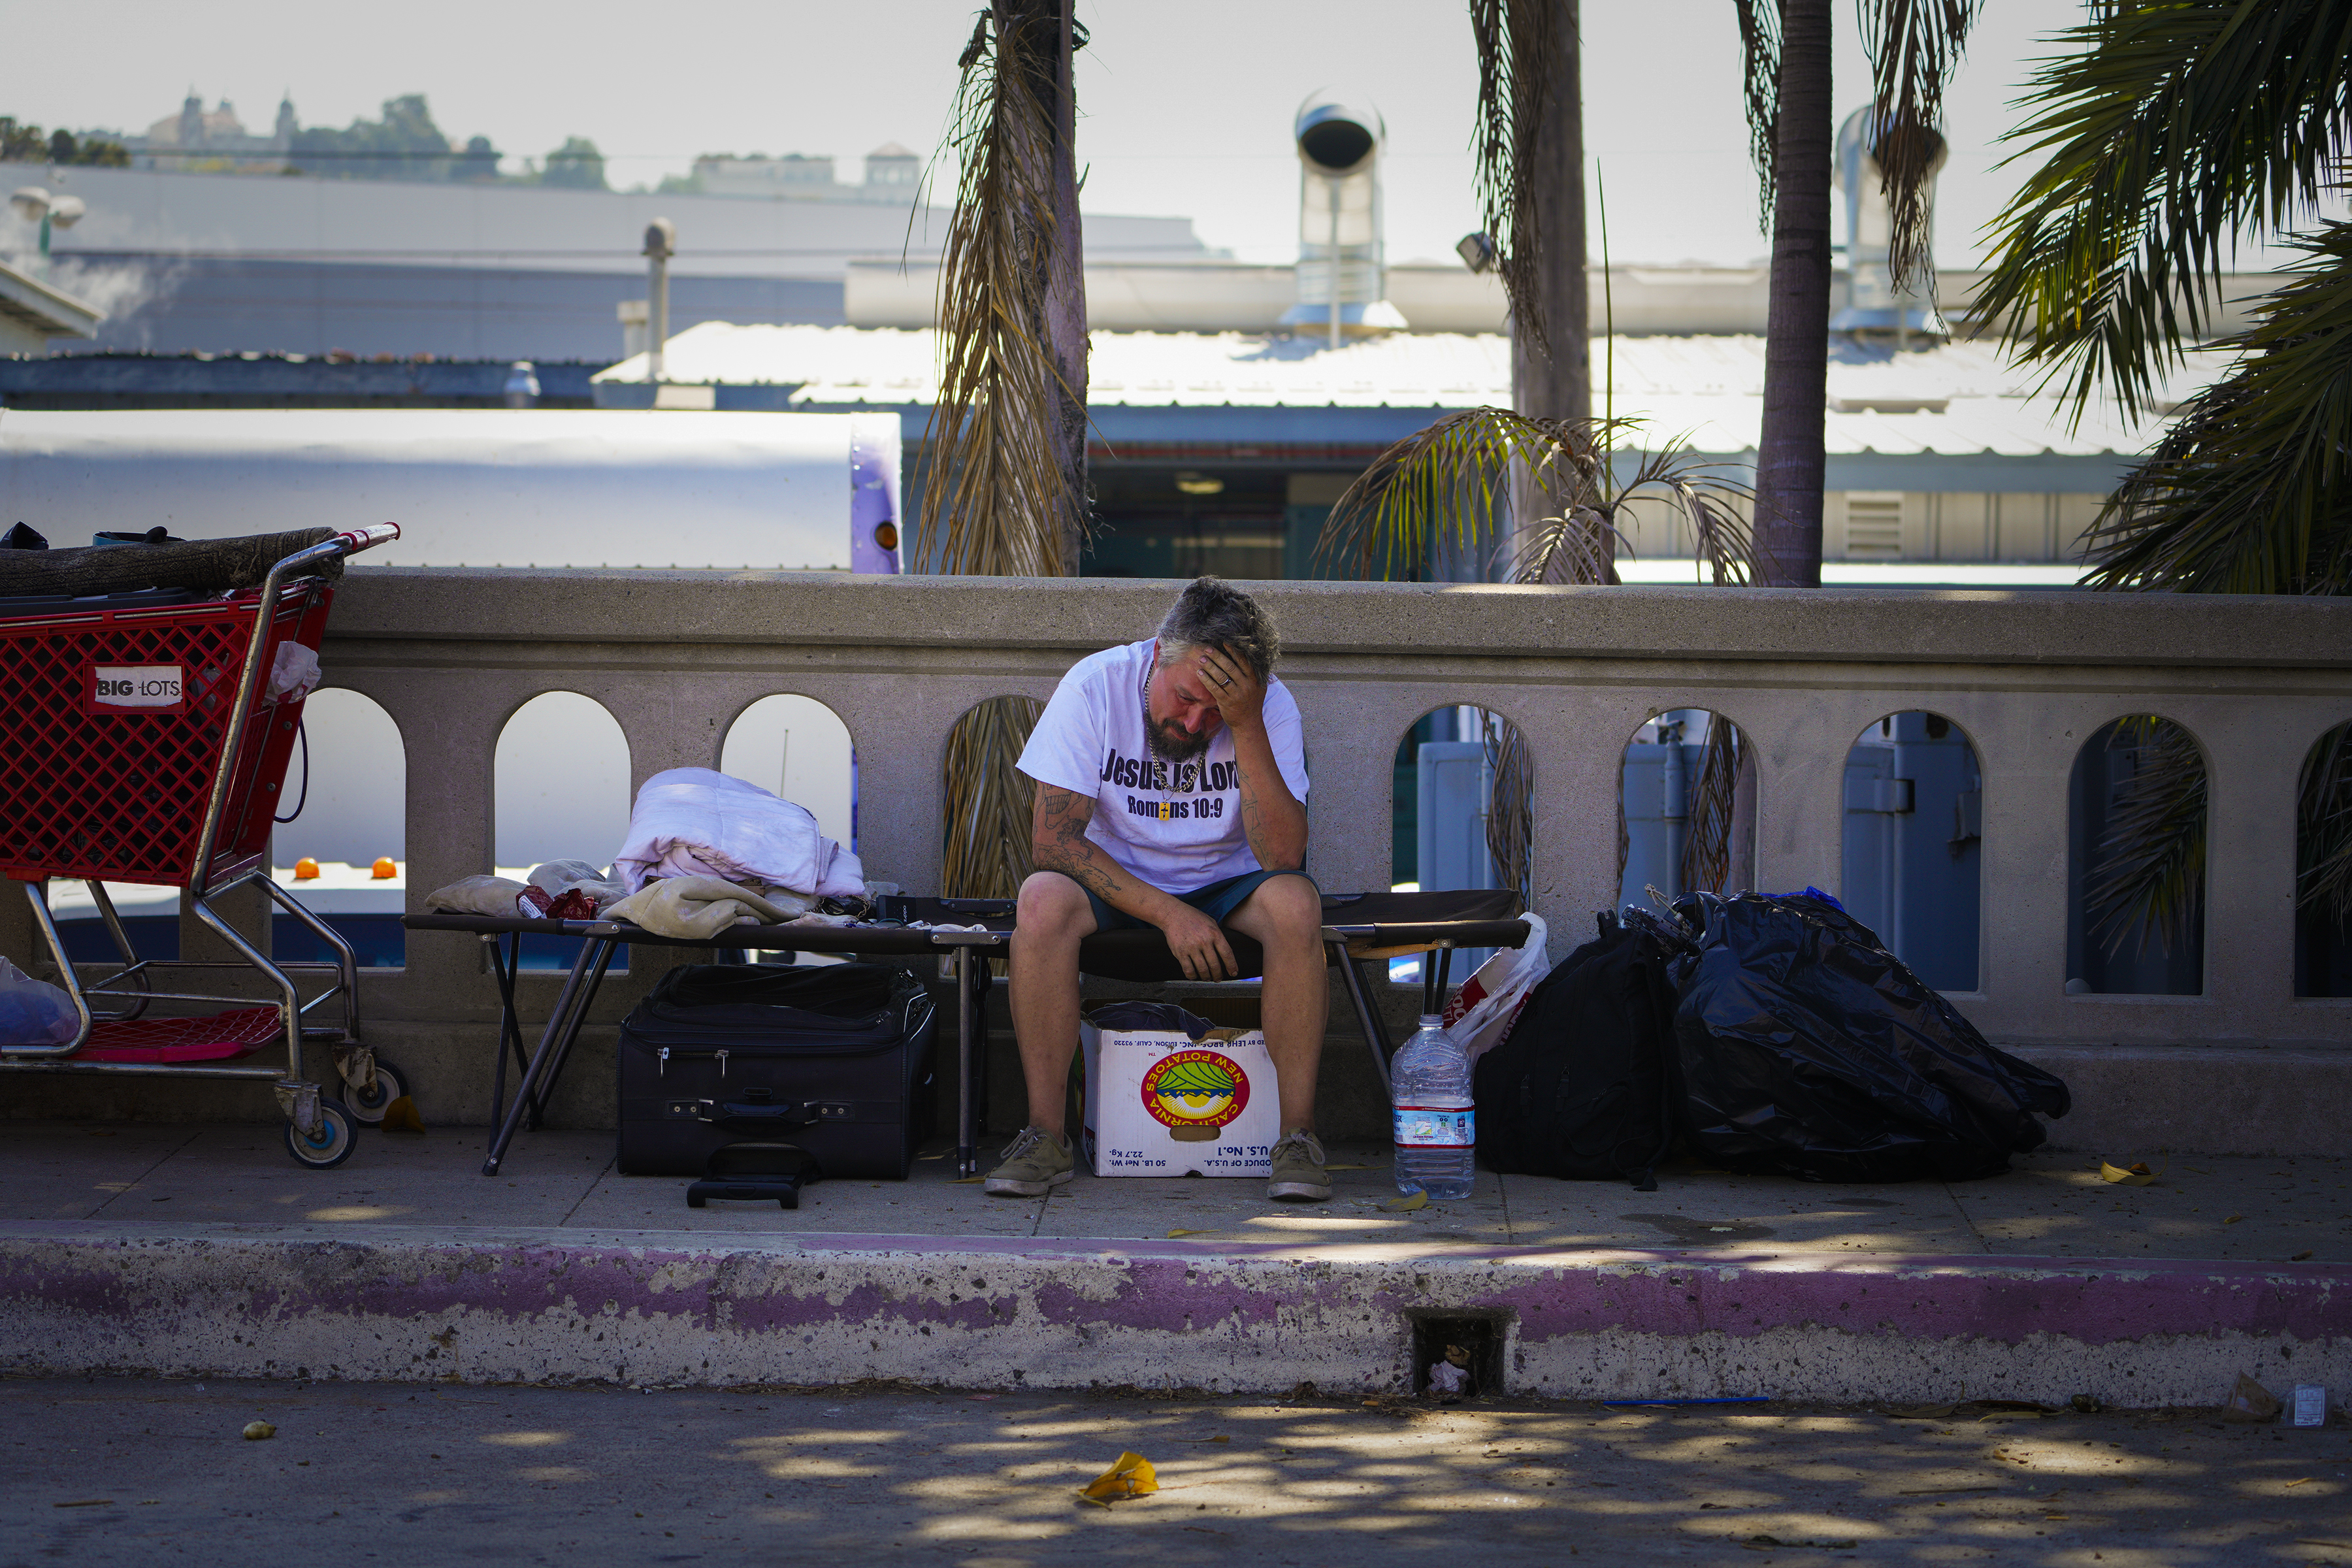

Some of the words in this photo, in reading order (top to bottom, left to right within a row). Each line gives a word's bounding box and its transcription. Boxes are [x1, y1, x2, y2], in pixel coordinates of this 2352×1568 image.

[98, 680, 133, 696] BIG
[141, 680, 180, 696] LOTS
[1102, 748, 1168, 791] Jesus
[1128, 795, 1188, 818] Romns
[1192, 798, 1223, 818] 10:9
[1146, 1053, 1211, 1092] POTATOES
[1215, 1056, 1243, 1084] NEW
[1109, 1149, 1122, 1158] Kg.
[1218, 1147, 1243, 1156] No.1
[1247, 1146, 1268, 1156] U.S.
